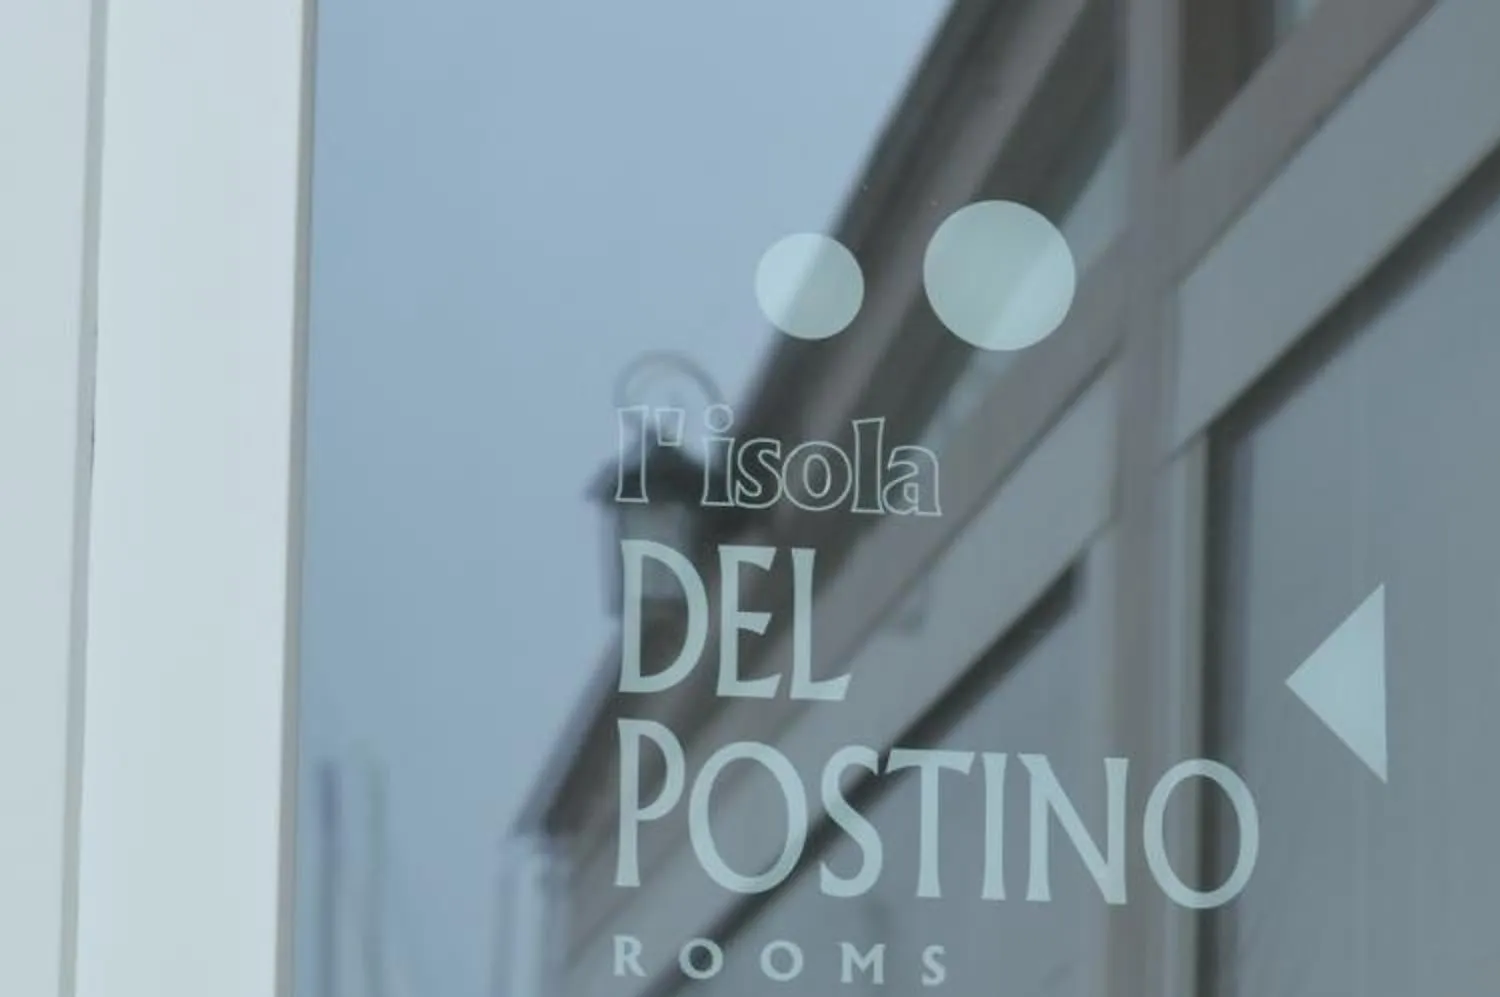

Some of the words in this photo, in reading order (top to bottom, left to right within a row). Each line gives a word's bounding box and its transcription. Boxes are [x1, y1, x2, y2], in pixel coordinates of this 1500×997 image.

[614, 403, 942, 517] l'isola
[617, 538, 852, 701] DEL
[613, 717, 1260, 910] POSTINO
[612, 935, 947, 986] ROOMS
